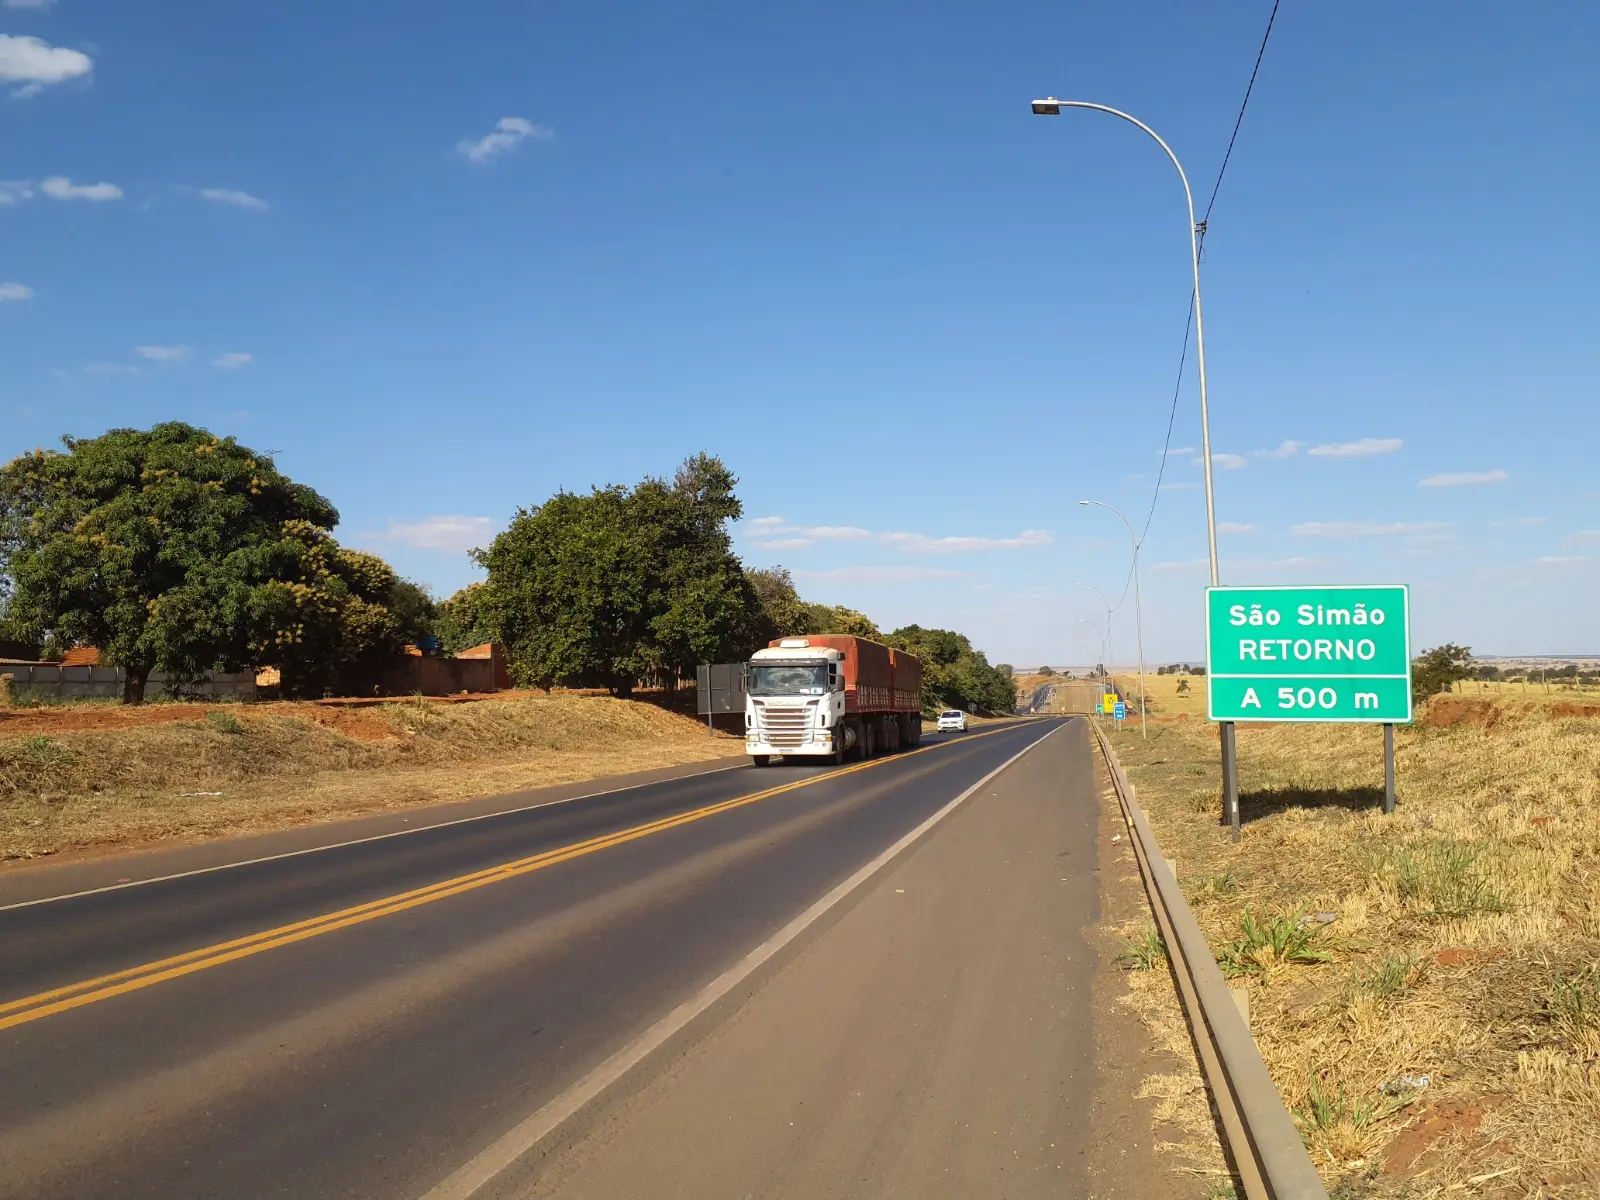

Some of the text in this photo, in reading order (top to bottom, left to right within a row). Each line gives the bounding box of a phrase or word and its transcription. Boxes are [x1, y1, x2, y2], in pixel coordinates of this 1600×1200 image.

[1229, 603, 1385, 627] São Simão
[1239, 638, 1376, 661] RETORNO
[1240, 687, 1379, 709] A 500 m
